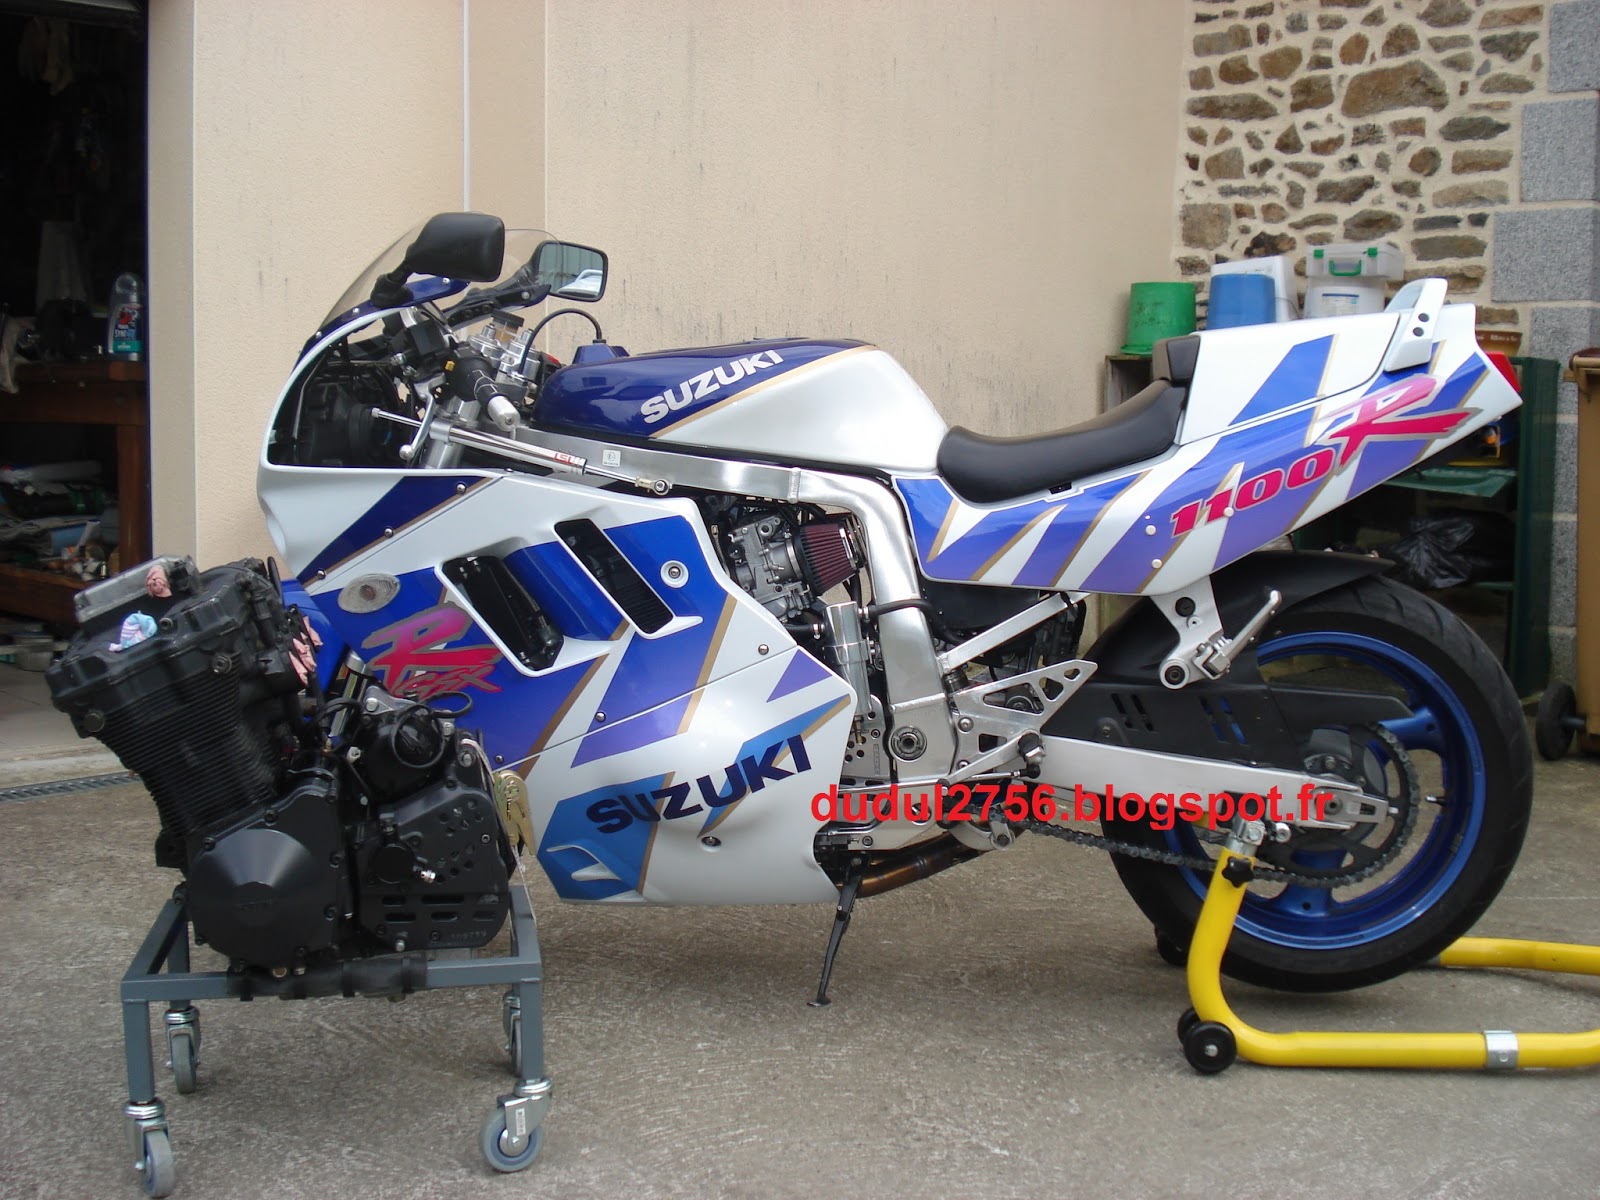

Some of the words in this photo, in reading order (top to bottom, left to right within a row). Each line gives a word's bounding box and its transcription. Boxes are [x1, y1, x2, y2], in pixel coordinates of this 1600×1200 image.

[640, 349, 784, 425] SUZUKI
[1170, 447, 1336, 538] 1100
[586, 734, 812, 834] SUZUKI
